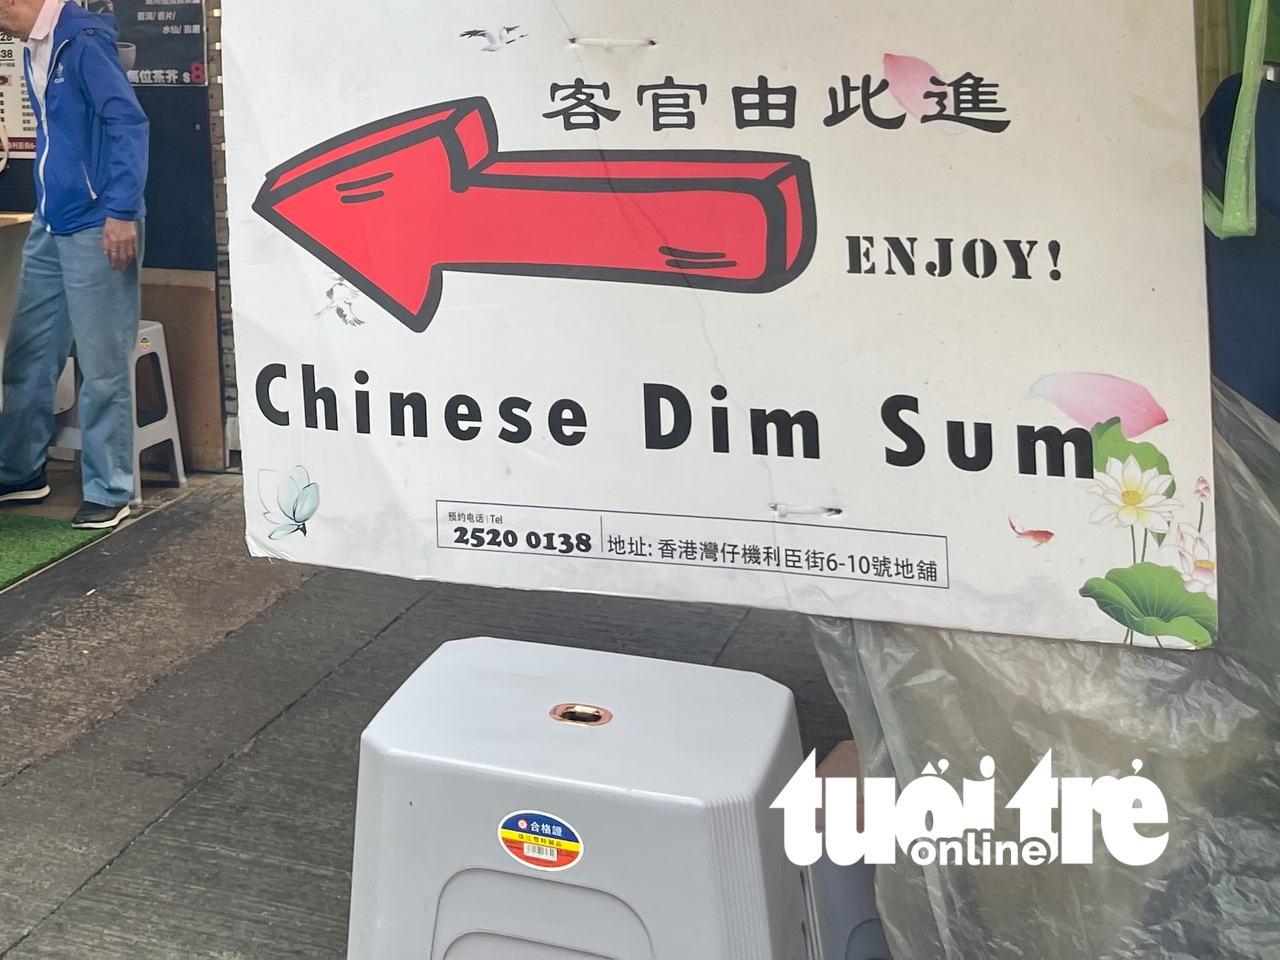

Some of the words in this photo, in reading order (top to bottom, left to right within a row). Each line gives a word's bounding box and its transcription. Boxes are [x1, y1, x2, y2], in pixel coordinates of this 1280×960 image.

[541, 71, 1012, 134] 客官由此進
[845, 235, 1062, 281] ENJOY!
[255, 363, 588, 447] Chinese
[643, 382, 820, 460] Dim
[885, 395, 1095, 480] Sum
[447, 511, 485, 524] 预约电话
[490, 514, 503, 524] Tel
[453, 526, 518, 548] 2520
[526, 530, 592, 553] 0138
[607, 534, 652, 558] 地址:
[657, 539, 938, 582] 香港灣仔機利臣街6-10號地舖
[530, 821, 562, 836] 合格證
